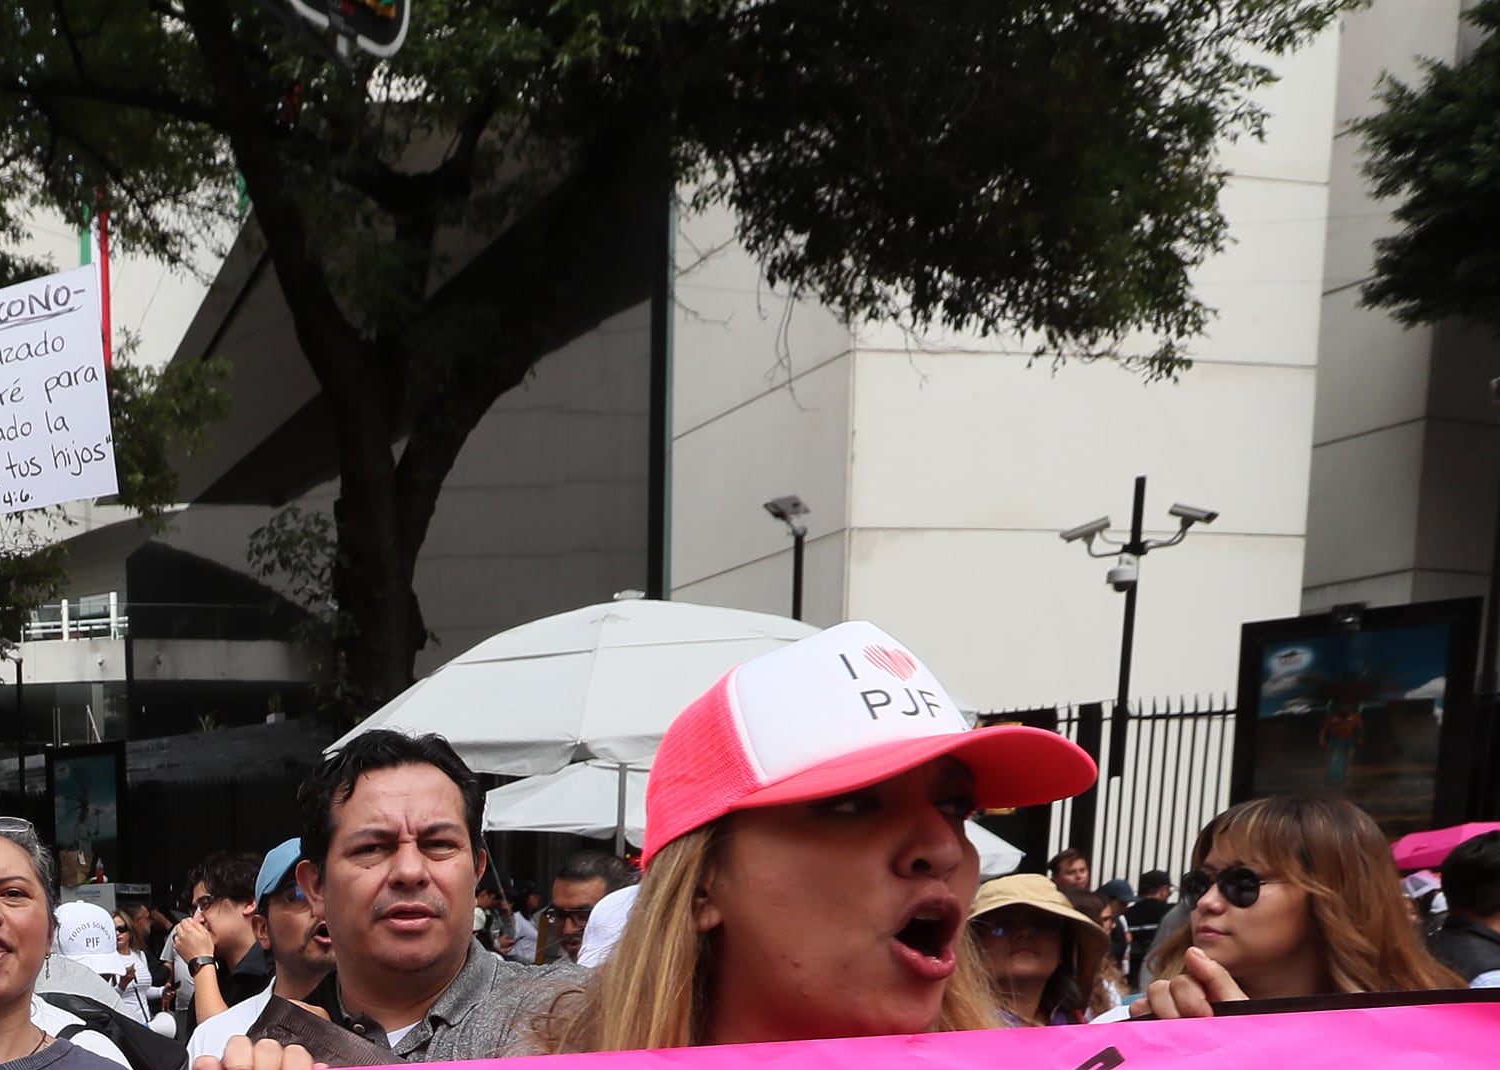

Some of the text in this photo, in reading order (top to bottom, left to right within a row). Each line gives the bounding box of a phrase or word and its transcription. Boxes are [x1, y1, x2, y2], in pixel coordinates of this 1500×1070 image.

[44, 363, 100, 405] para
[44, 410, 71, 435] la
[5, 451, 43, 481] tus
[51, 433, 113, 477] hijos"
[837, 653, 860, 681] I
[859, 687, 943, 721] PJF
[67, 921, 112, 943] TODOS SOMOS
[85, 936, 101, 949] PJF
